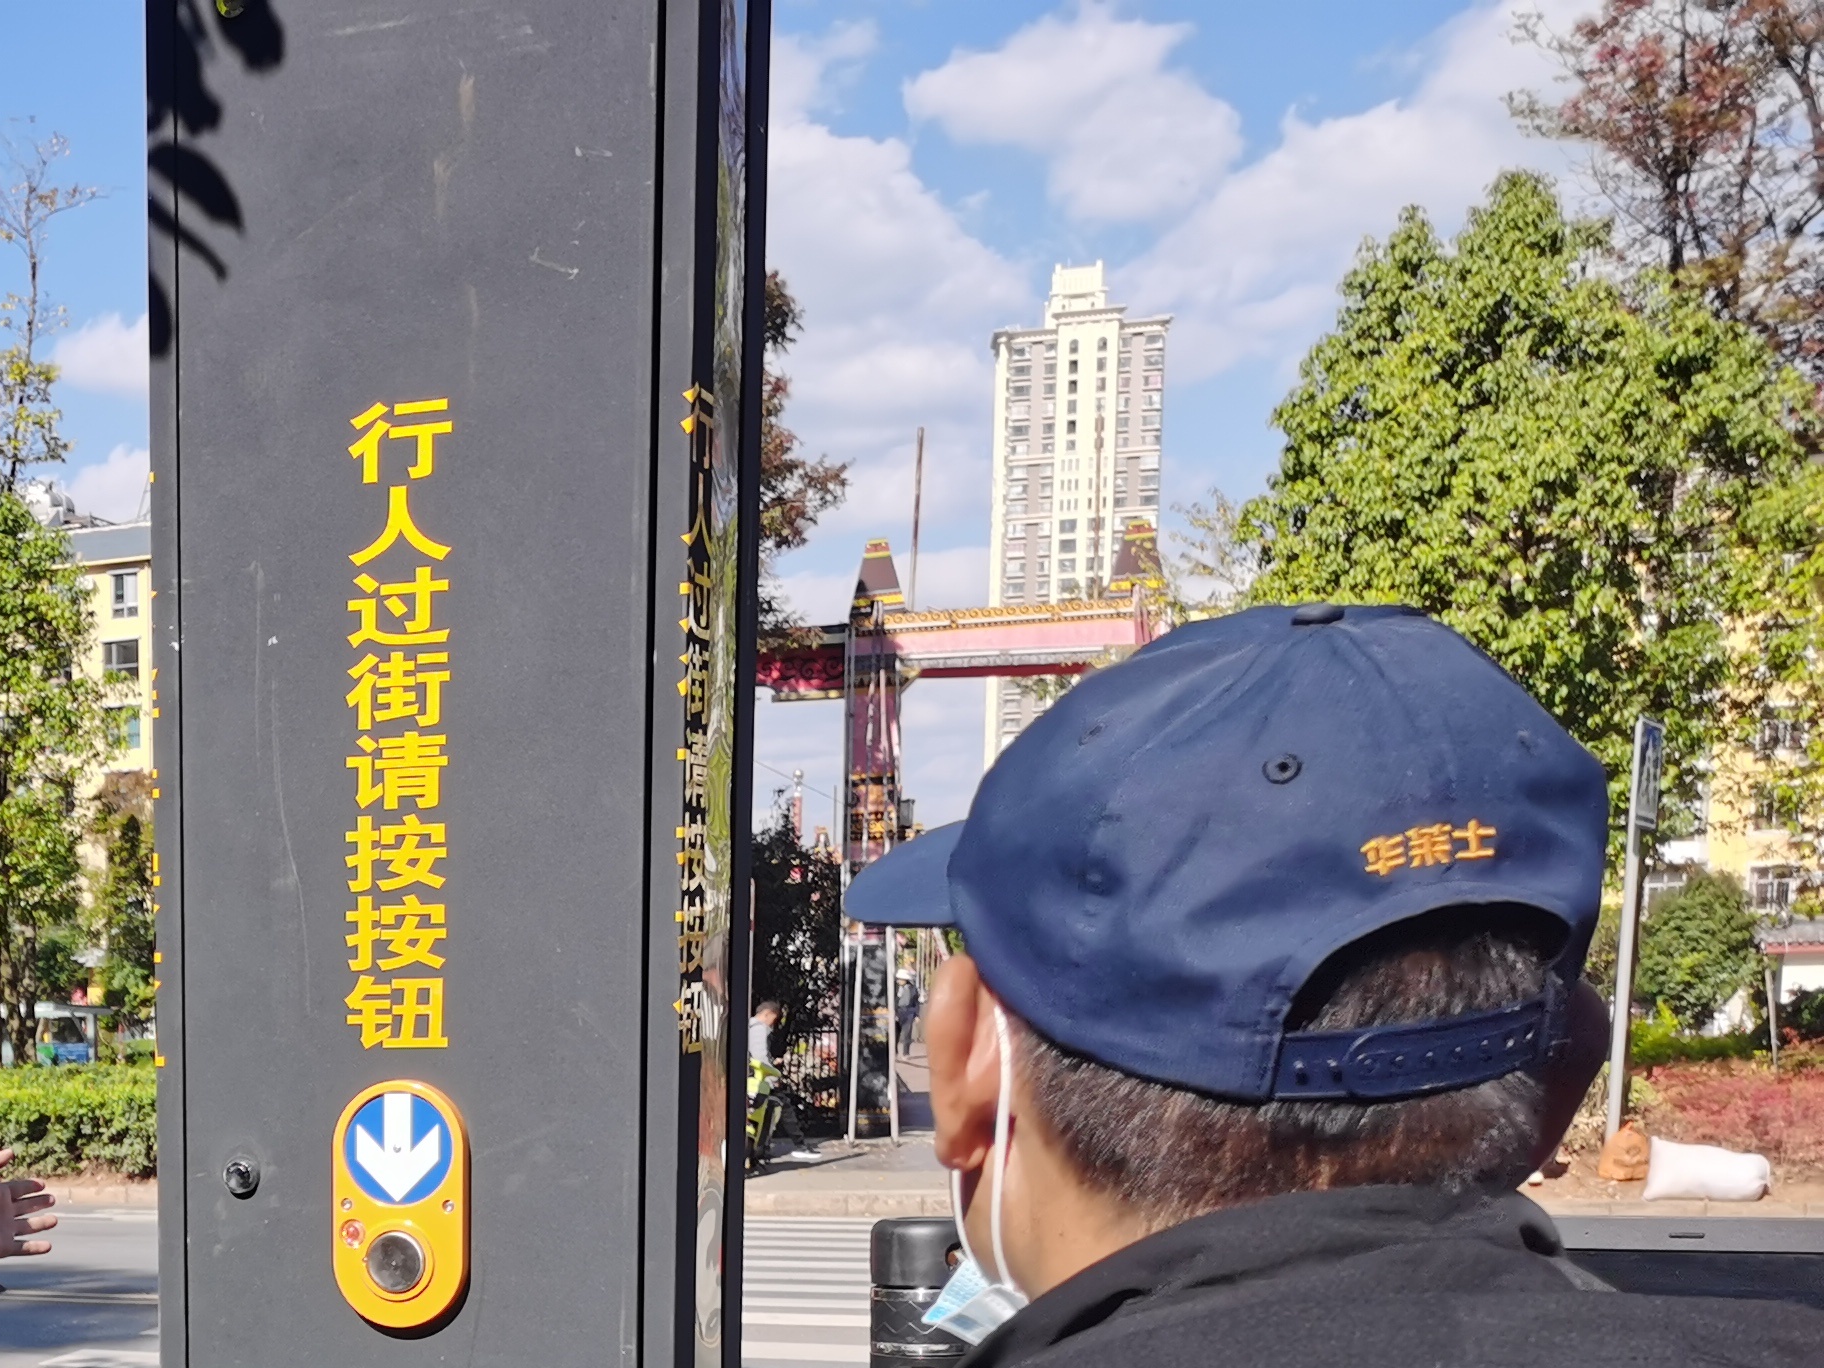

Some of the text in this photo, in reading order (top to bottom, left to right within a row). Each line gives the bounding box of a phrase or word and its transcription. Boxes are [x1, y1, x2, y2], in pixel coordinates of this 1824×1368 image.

[344, 397, 454, 1050] 行人过街请按按钮
